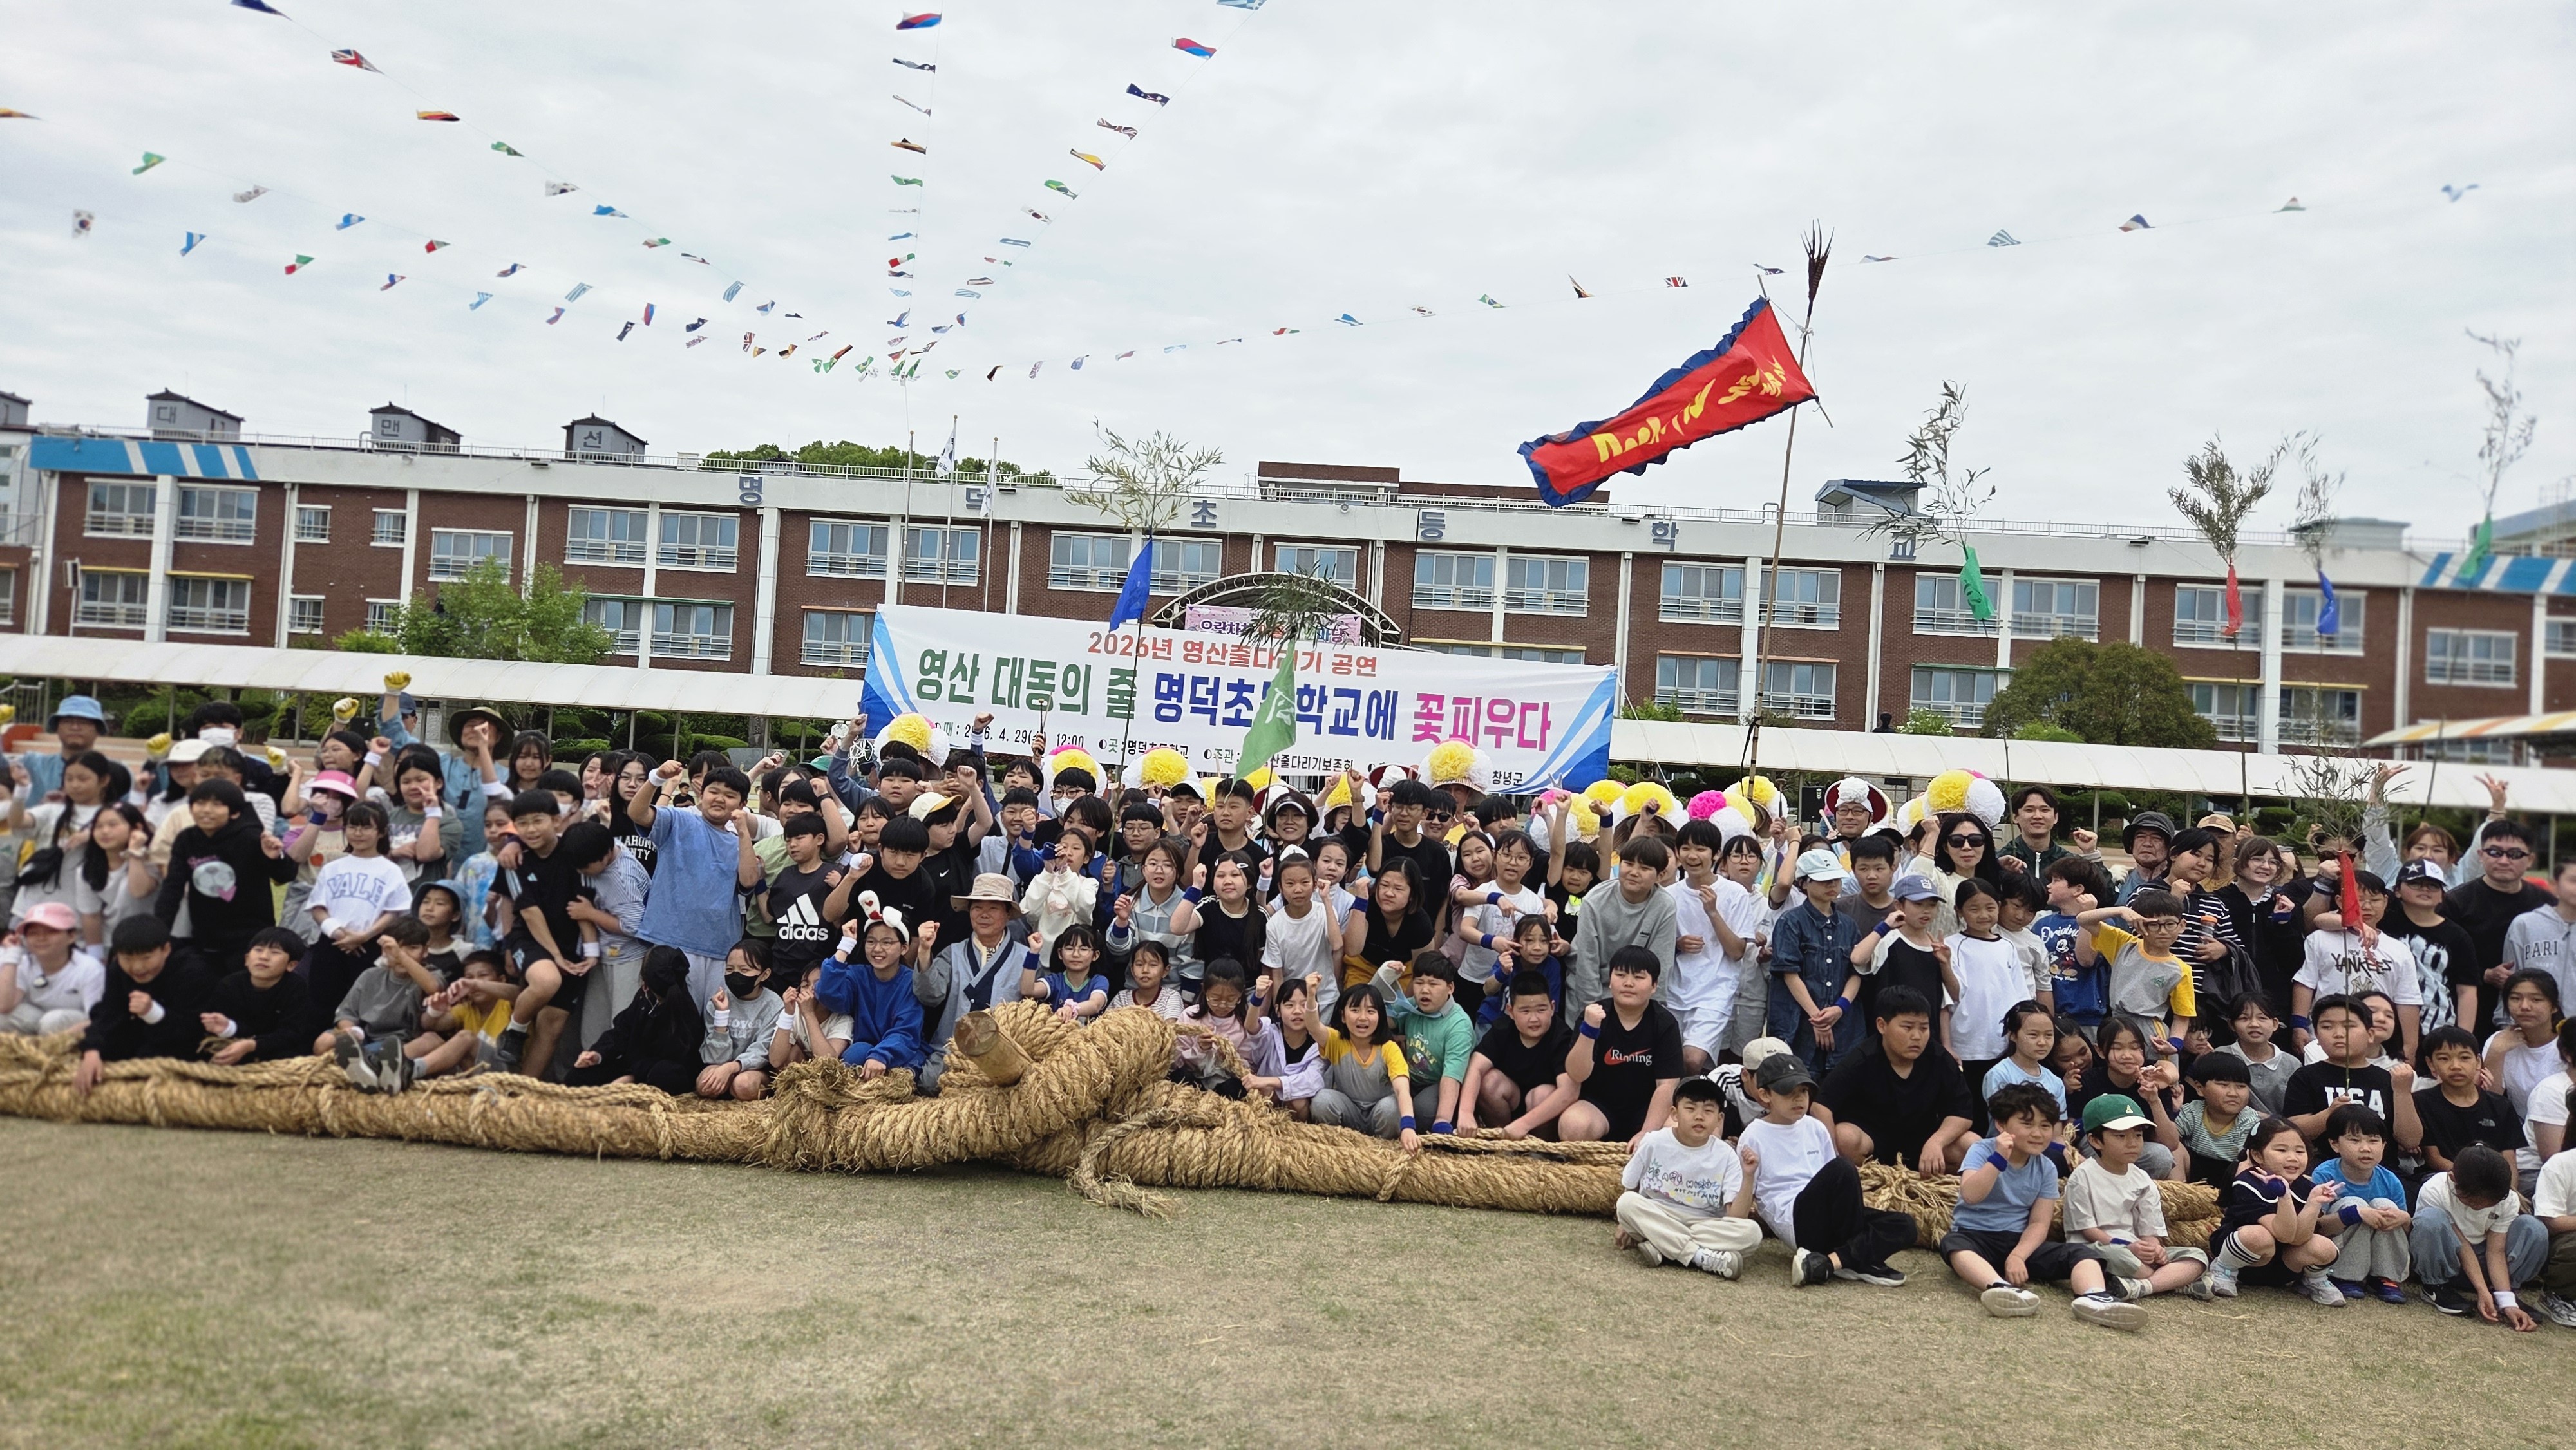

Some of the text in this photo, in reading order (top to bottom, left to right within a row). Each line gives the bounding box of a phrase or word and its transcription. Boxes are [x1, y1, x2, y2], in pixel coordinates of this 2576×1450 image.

[156, 406, 601, 448] 대 맨 션
[739, 476, 762, 505] 명
[1190, 500, 1217, 527] 초
[1419, 511, 1446, 540] 등
[1652, 521, 1679, 551] 학
[1088, 631, 1172, 661] 2026년
[1331, 654, 1377, 678] 공연
[916, 648, 1551, 751] 영산 대동의 줄 명덕초학교에 꽃피우다
[964, 724, 994, 741] 26.
[1056, 733, 1084, 748] 12:00
[1108, 738, 1118, 753] 곳
[1264, 754, 1354, 773] 산줄다리기보존회
[1492, 770, 1522, 787] 창녕군
[327, 872, 386, 909] YALE
[779, 923, 829, 941] adidas
[2331, 953, 2392, 978] YANKEES
[1611, 1049, 1653, 1066] Running
